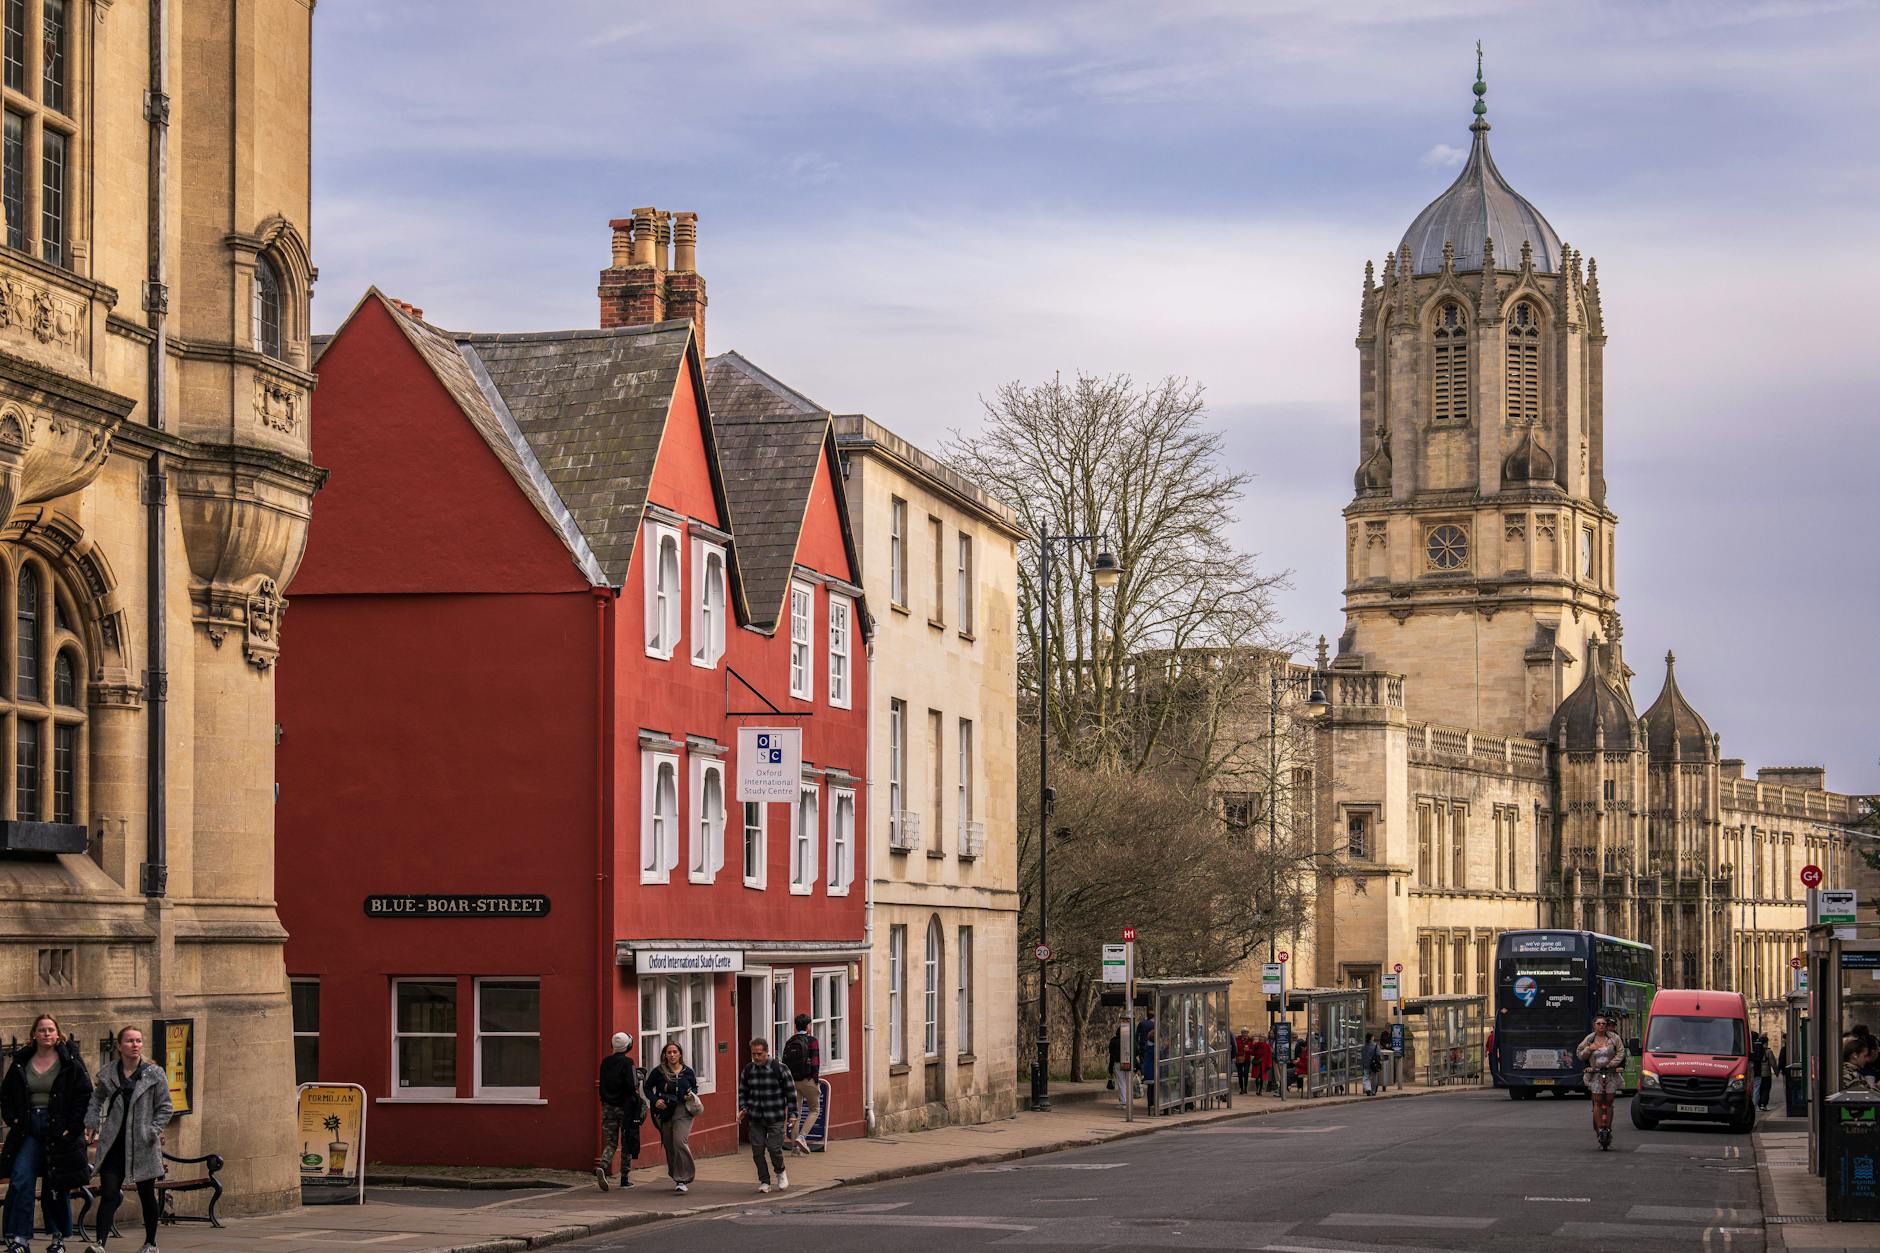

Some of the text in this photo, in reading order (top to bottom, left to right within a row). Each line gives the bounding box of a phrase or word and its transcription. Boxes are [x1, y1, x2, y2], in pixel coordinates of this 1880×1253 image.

[1803, 871, 1819, 881] G4
[1124, 930, 1134, 939] H1
[649, 954, 731, 970] Oxford International Study Centre
[1791, 959, 1800, 967] G3
[1549, 994, 1574, 1003] amping
